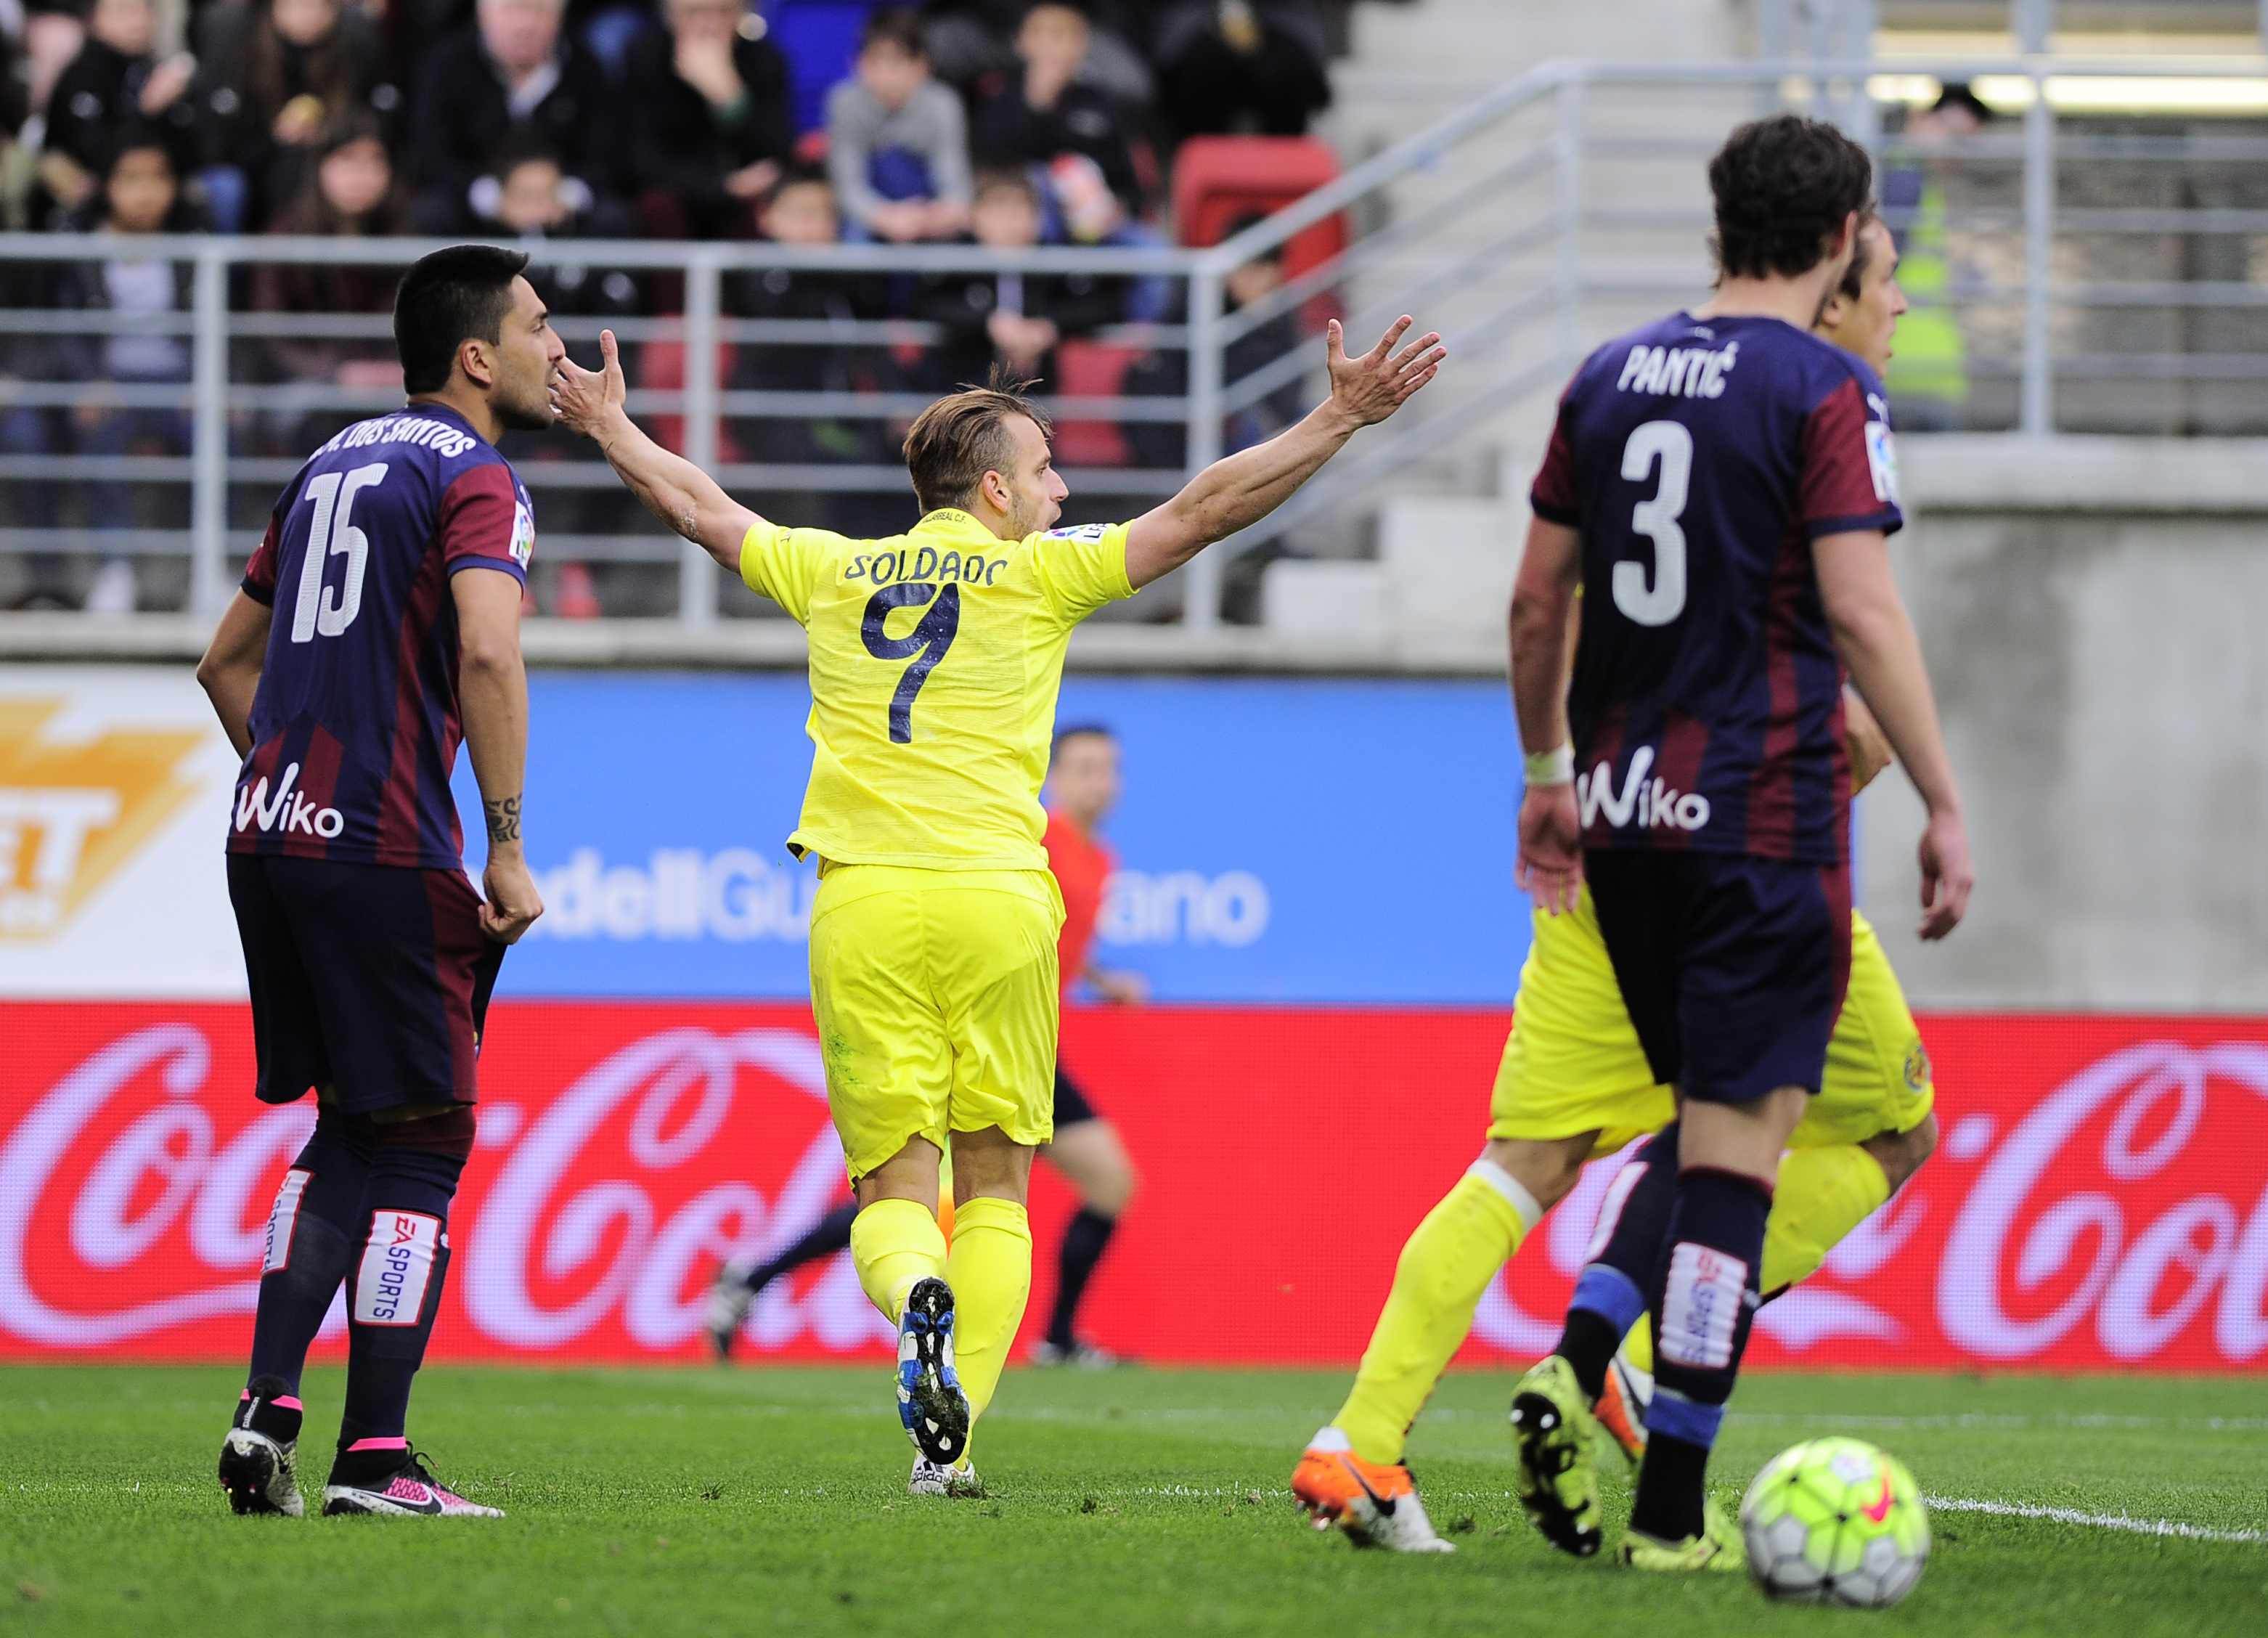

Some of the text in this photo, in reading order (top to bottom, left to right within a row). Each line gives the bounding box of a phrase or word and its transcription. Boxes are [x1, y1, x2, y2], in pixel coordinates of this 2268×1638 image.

[342, 419, 395, 449] DOS
[380, 417, 477, 458] SANTOS
[291, 463, 388, 643] 15
[1612, 420, 1692, 626] 3
[861, 582, 960, 743] 9
[236, 762, 343, 838] Wiko
[1577, 745, 1710, 831] Wiko
[373, 1215, 416, 1321] EA SPORTS
